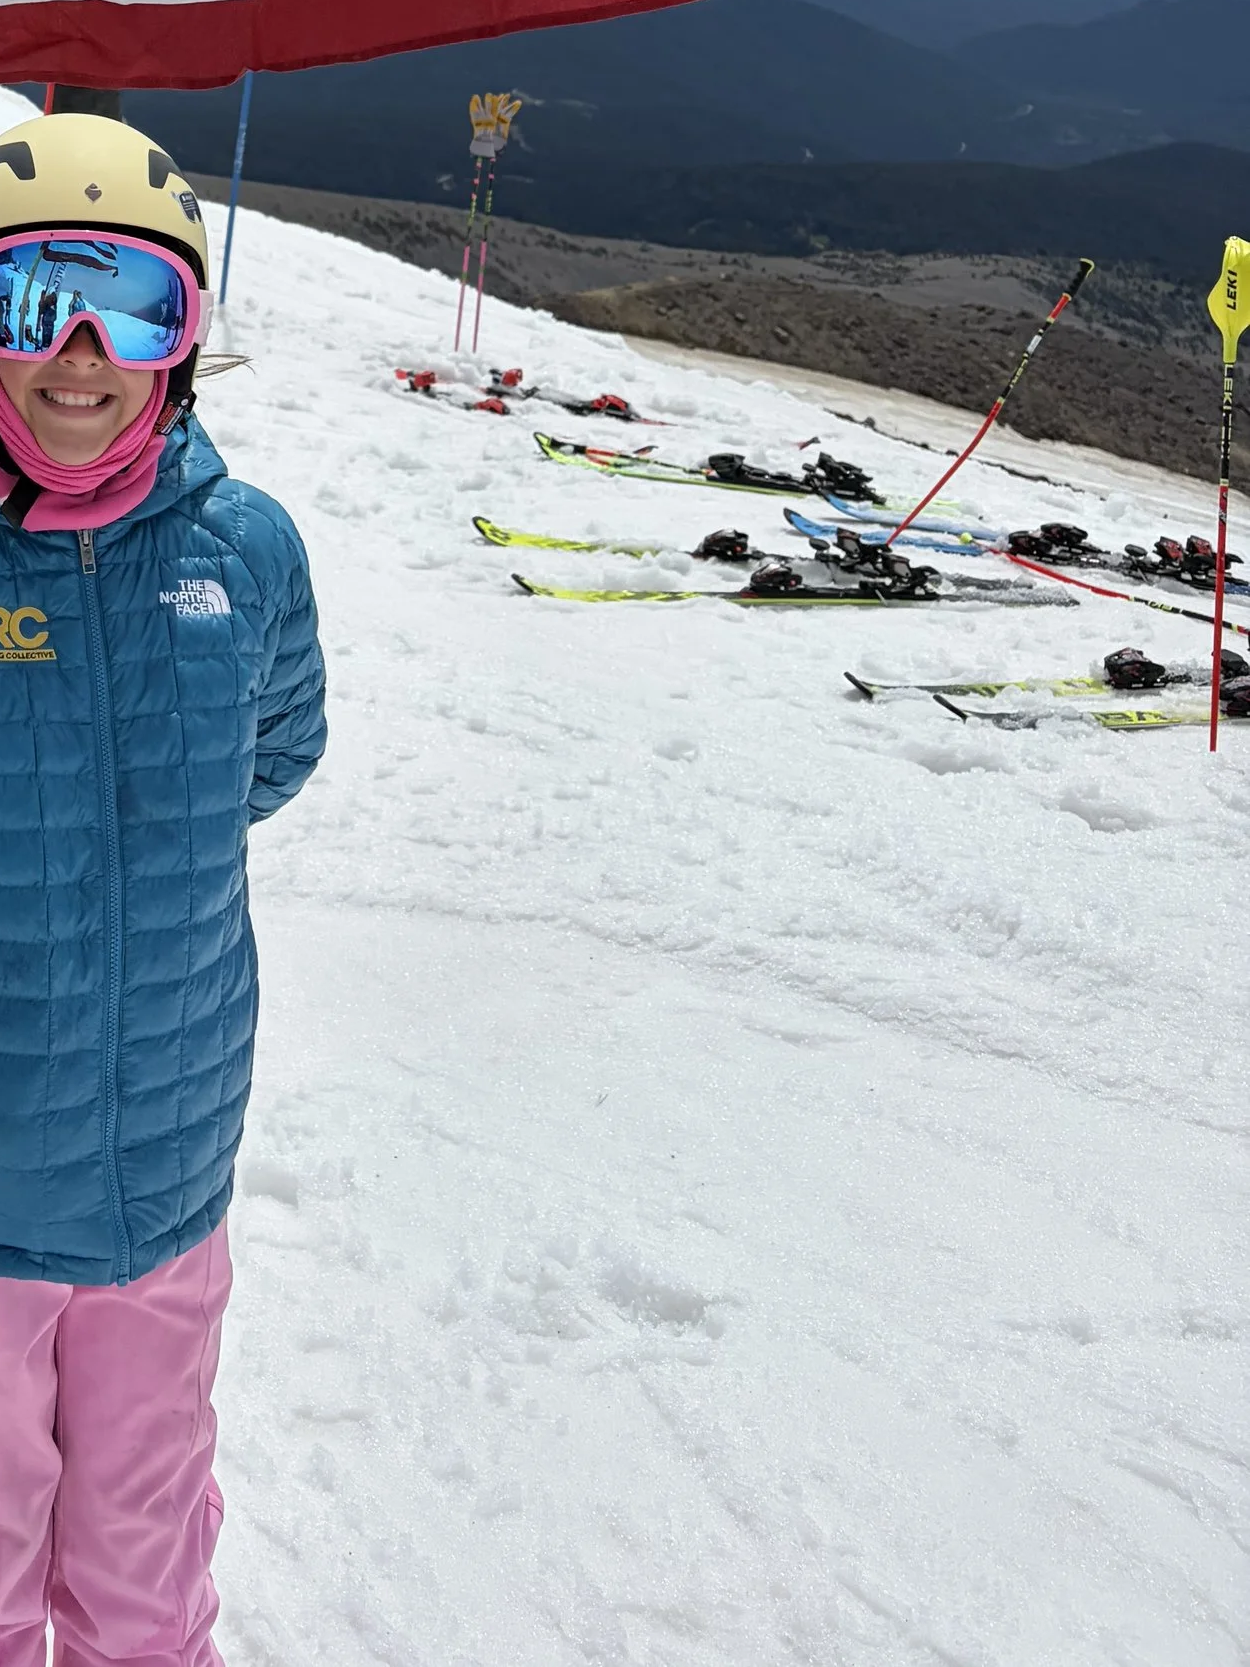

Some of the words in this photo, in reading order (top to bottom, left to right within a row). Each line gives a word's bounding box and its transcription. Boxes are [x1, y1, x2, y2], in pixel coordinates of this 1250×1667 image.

[1226, 269, 1238, 310] LEKI
[1223, 364, 1234, 410] LEKI
[178, 579, 205, 591] THE
[159, 591, 206, 603] NORTH
[175, 603, 208, 616] FACE
[5, 651, 54, 659] COLLECTIVE
